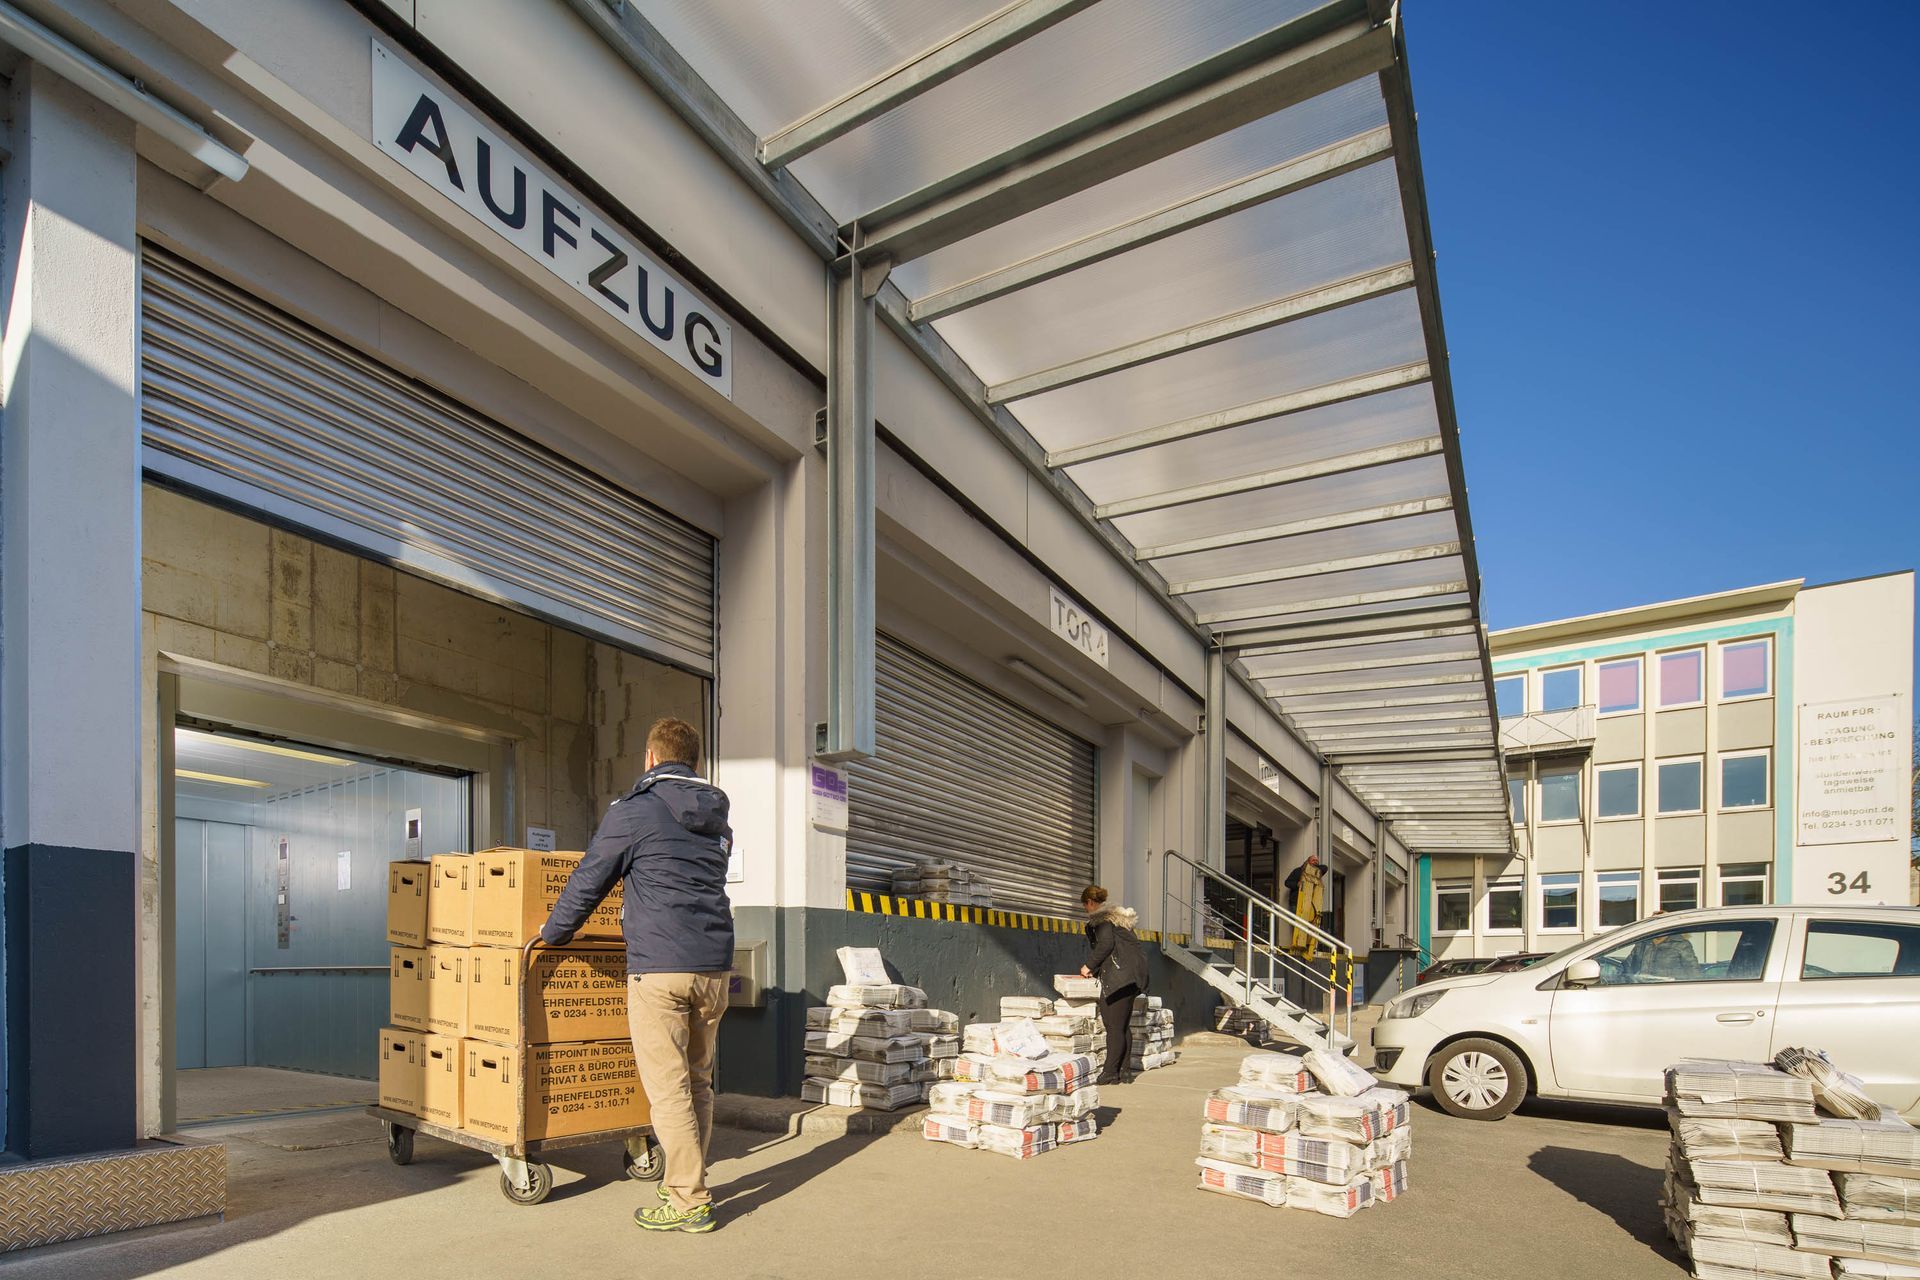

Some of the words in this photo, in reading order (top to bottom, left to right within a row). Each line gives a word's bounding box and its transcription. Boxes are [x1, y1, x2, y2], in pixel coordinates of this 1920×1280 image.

[395, 93, 722, 377] AUFZUG
[1054, 596, 1092, 652] TOR
[1817, 710, 1849, 720] RAUM
[1852, 707, 1875, 716] FÜR
[1802, 806, 1895, 818] info@mietpoint.de
[1822, 821, 1846, 829] 0234
[1855, 819, 1872, 827] 311
[1875, 818, 1894, 826] 071
[1827, 871, 1871, 895] 34
[536, 954, 592, 964] MIETPOINT
[593, 955, 603, 963] IN
[605, 955, 627, 963] BOC
[541, 969, 577, 978] LAGER
[580, 969, 587, 978] &
[590, 967, 619, 978] BÜRO
[542, 980, 580, 989] PRIVAT
[582, 980, 590, 988] &
[543, 997, 626, 1008] EHRENFELDSTR.
[564, 1009, 587, 1018] 0234
[536, 1048, 589, 1060] MIETPOINT
[591, 1048, 600, 1057] IN
[541, 1064, 575, 1075] LAGER
[578, 1063, 585, 1072] &
[588, 1060, 615, 1071] BÜRO
[618, 1058, 636, 1068] FÜR
[541, 1075, 578, 1086] PRIVAT
[580, 1074, 587, 1083] &
[590, 1070, 636, 1082] GEWERBE
[542, 1088, 623, 1104] EHRENFELDSTR.
[625, 1086, 635, 1095] 34
[562, 1103, 585, 1113] 0234
[594, 1097, 630, 1110] 31.10.71
